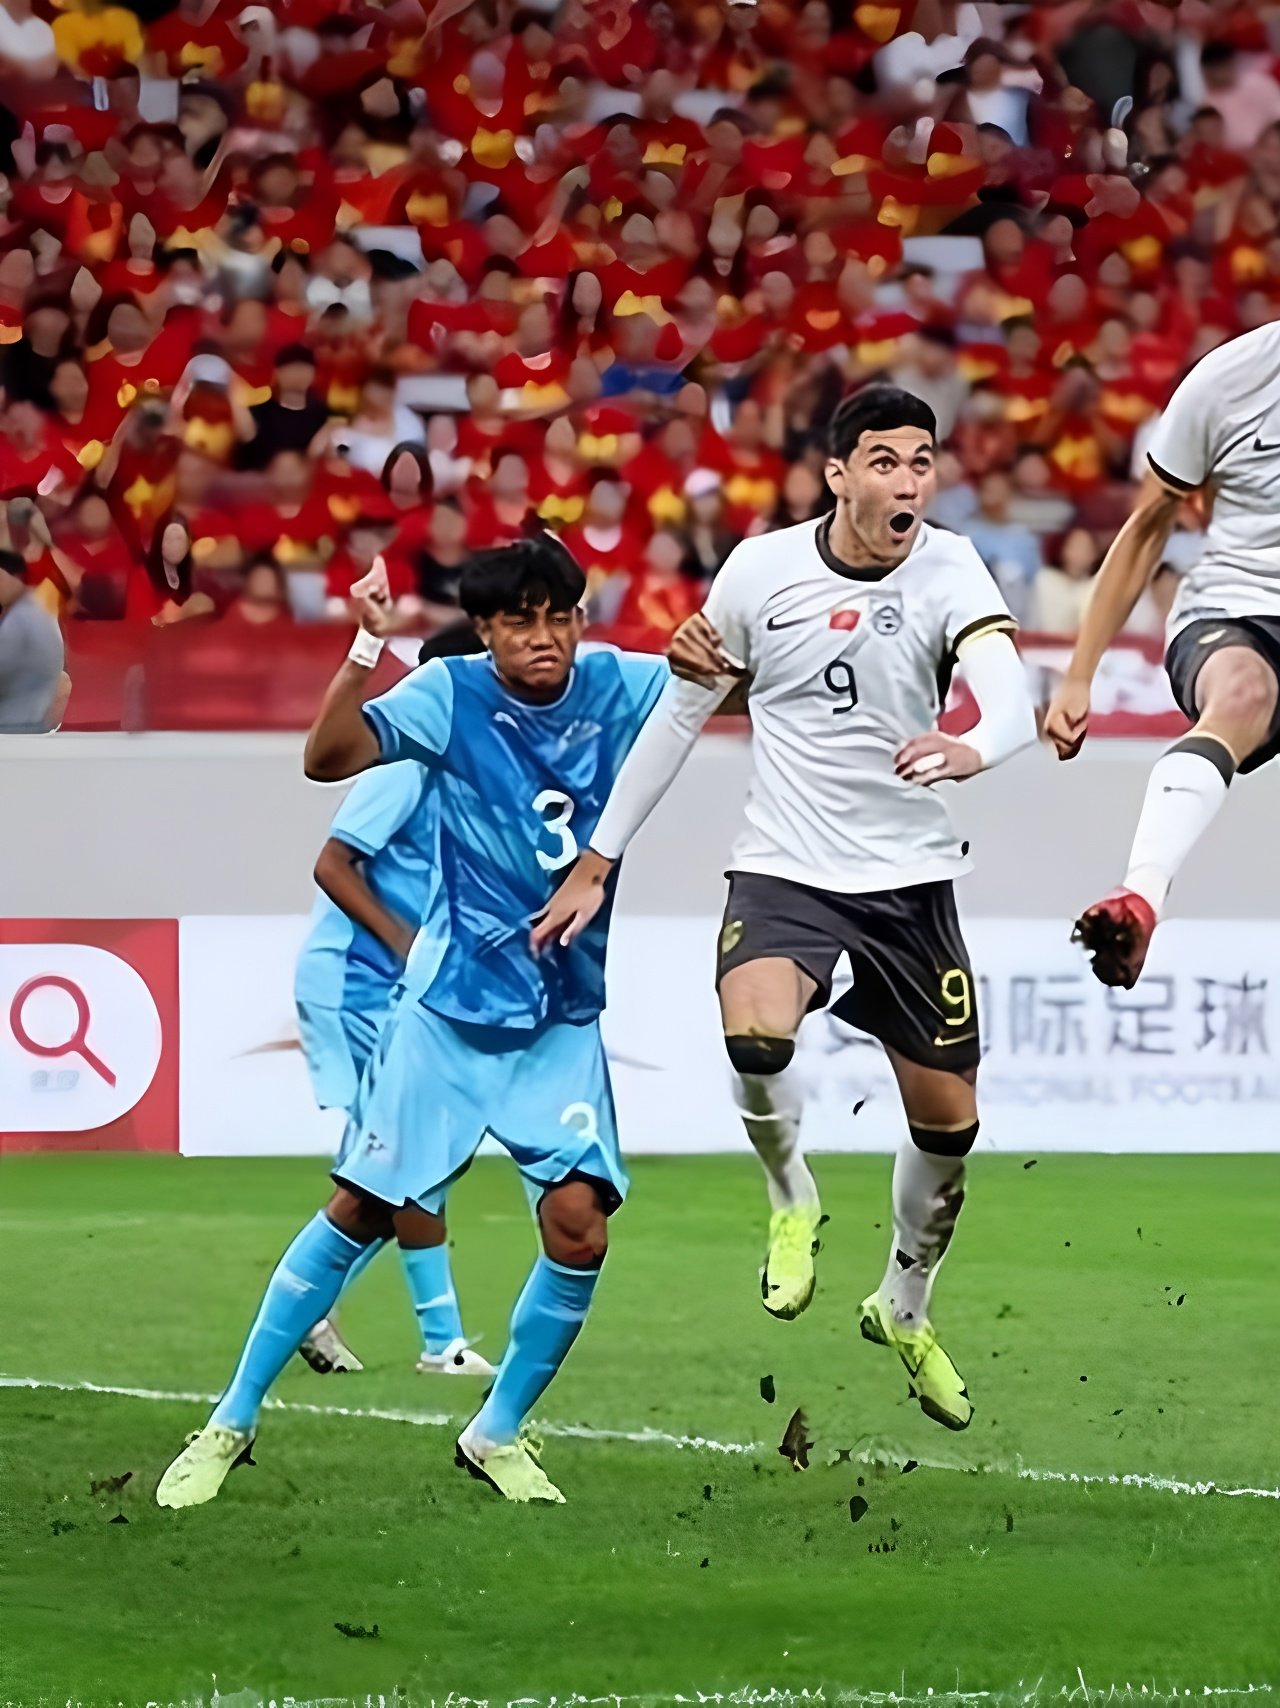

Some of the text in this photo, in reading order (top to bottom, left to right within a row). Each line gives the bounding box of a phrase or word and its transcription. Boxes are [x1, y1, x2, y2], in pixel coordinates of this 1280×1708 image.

[824, 659, 858, 715] 9
[532, 789, 578, 871] 3
[942, 968, 972, 1027] 9
